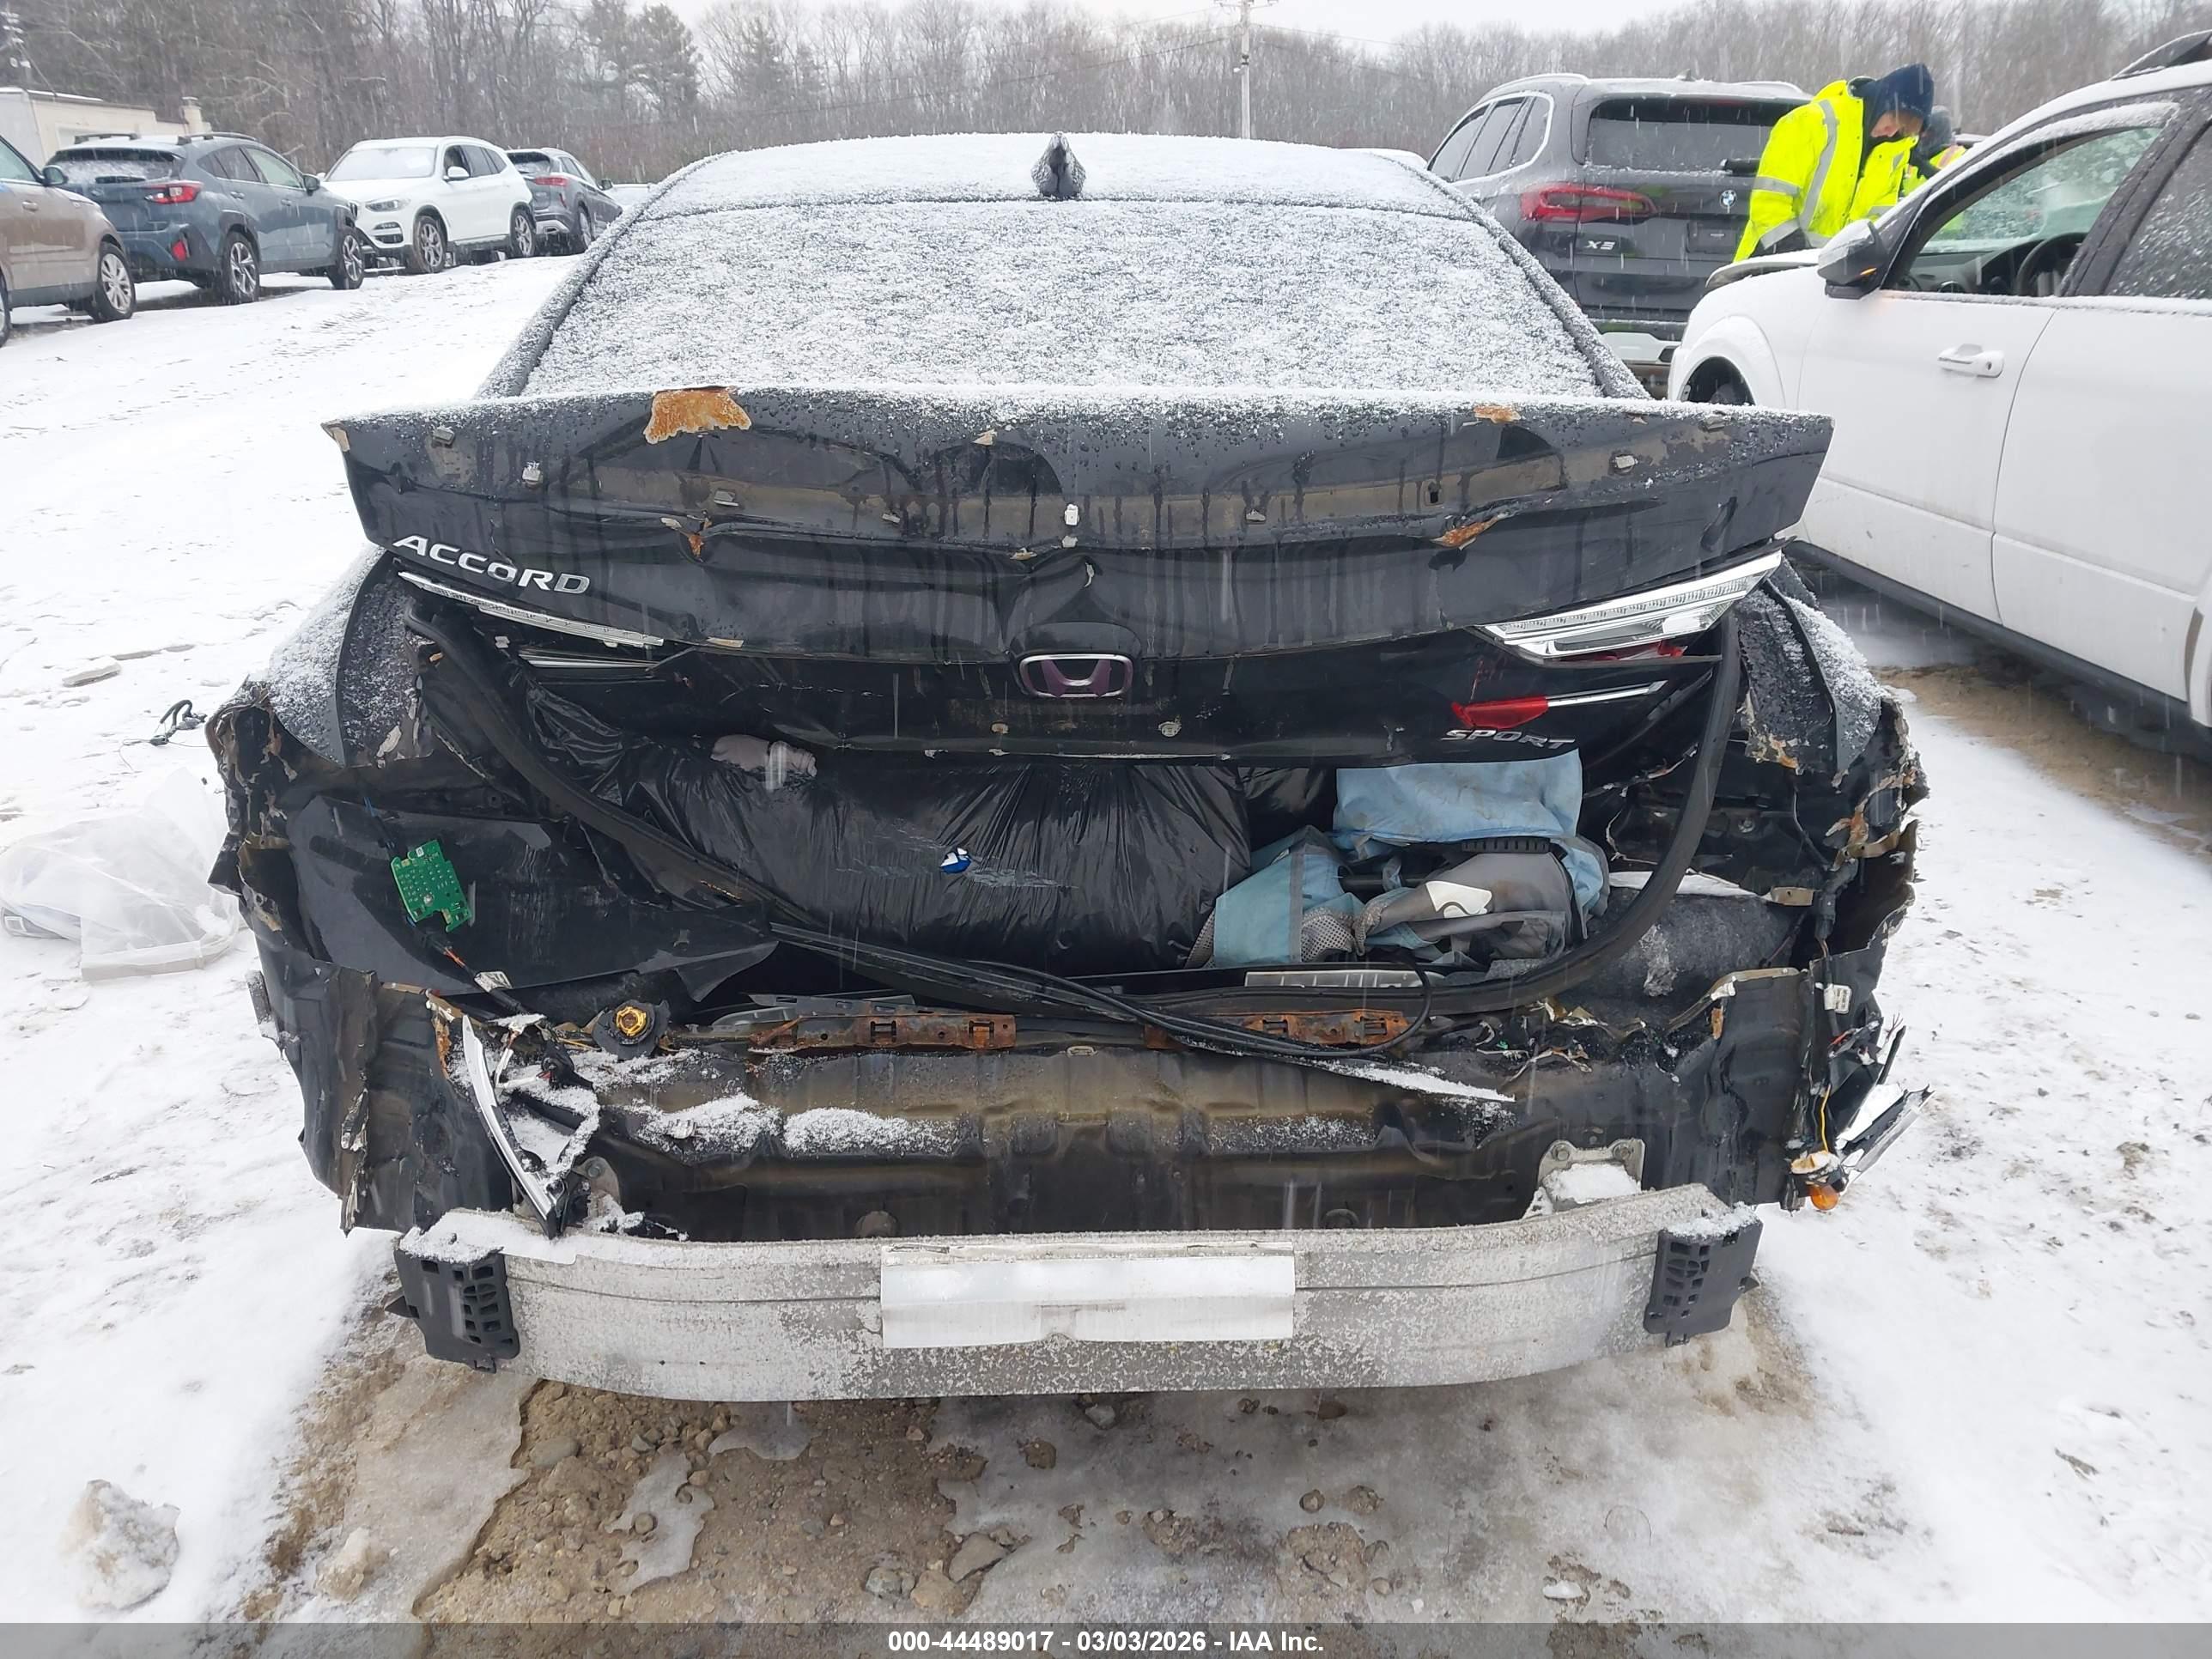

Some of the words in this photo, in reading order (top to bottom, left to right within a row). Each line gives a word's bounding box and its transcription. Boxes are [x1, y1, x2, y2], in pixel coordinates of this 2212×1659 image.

[1587, 240, 1616, 251] X5
[392, 534, 591, 594] ACCORD
[1440, 729, 1576, 750] SPORT
